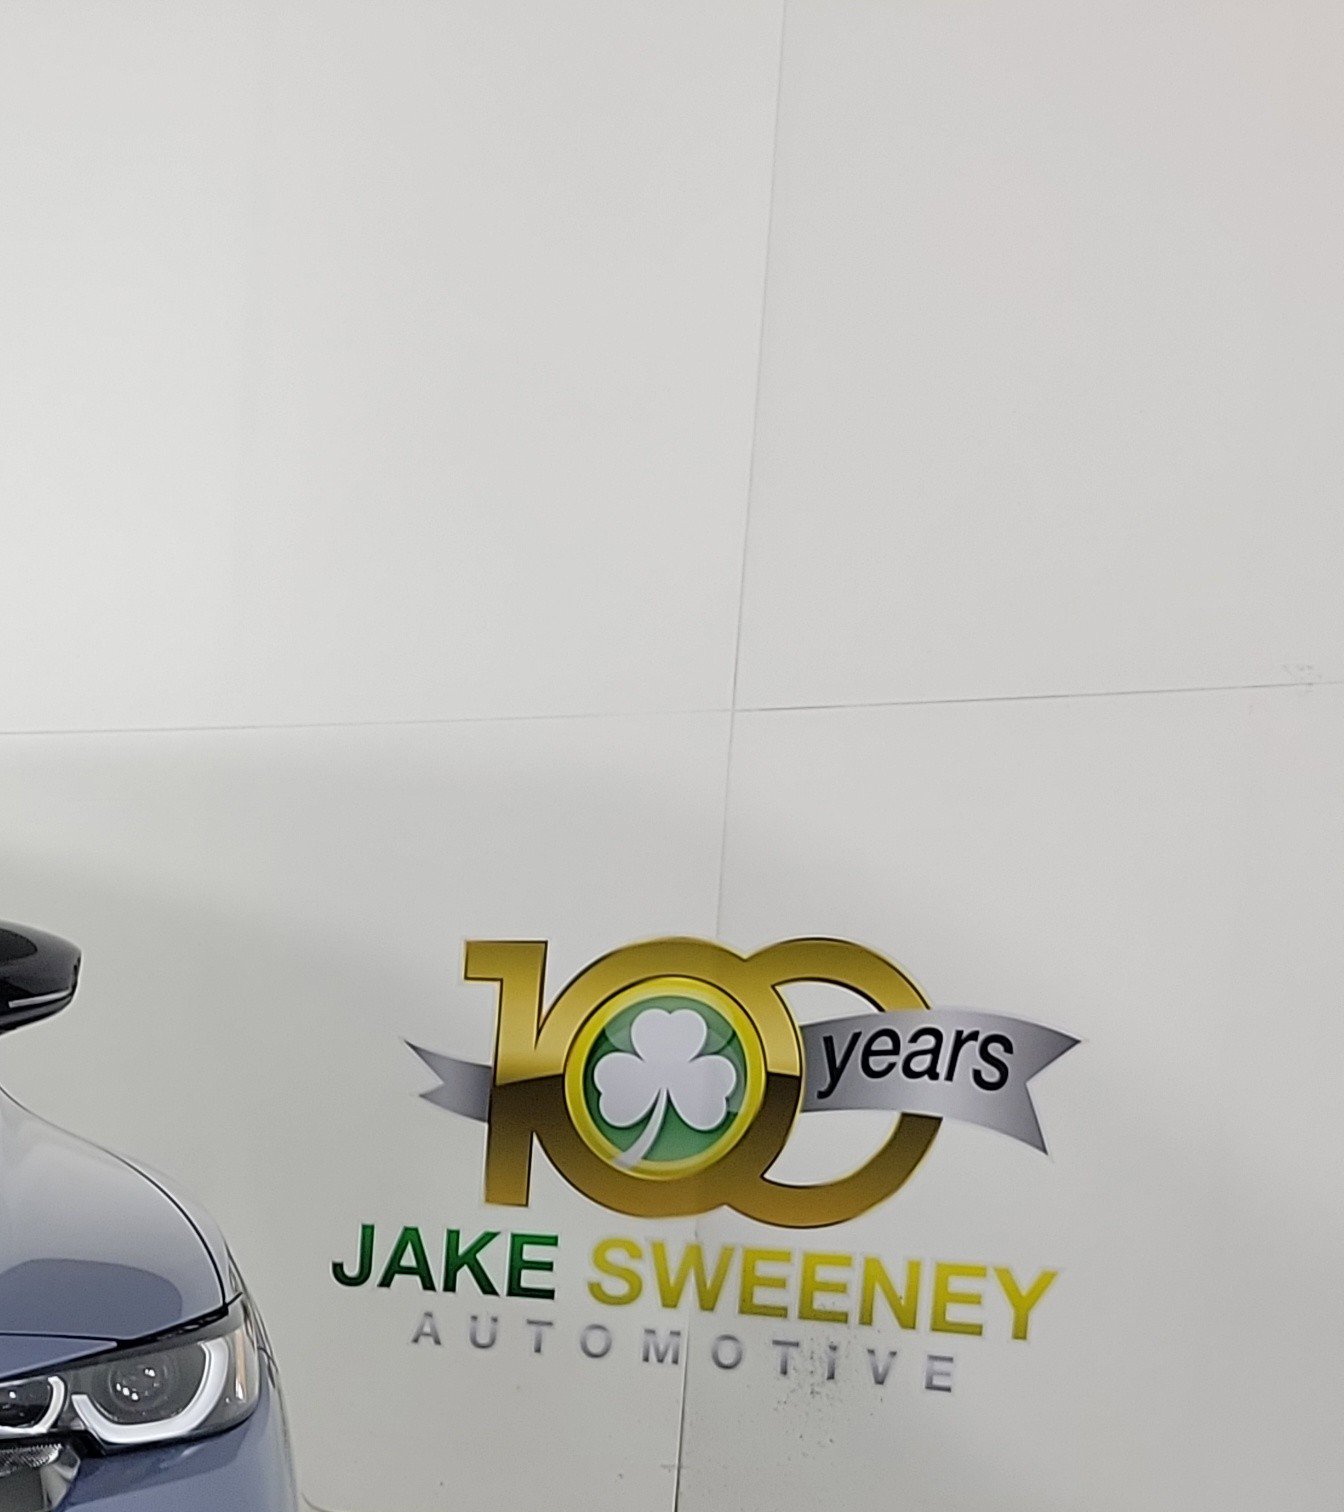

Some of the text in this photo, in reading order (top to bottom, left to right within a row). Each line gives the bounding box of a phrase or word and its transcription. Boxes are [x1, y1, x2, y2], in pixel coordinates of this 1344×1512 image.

[463, 936, 1014, 1229] 100 years
[331, 1223, 1058, 1341] JAKE SWEENEY
[412, 1311, 956, 1393] AUTOMOTIVE
